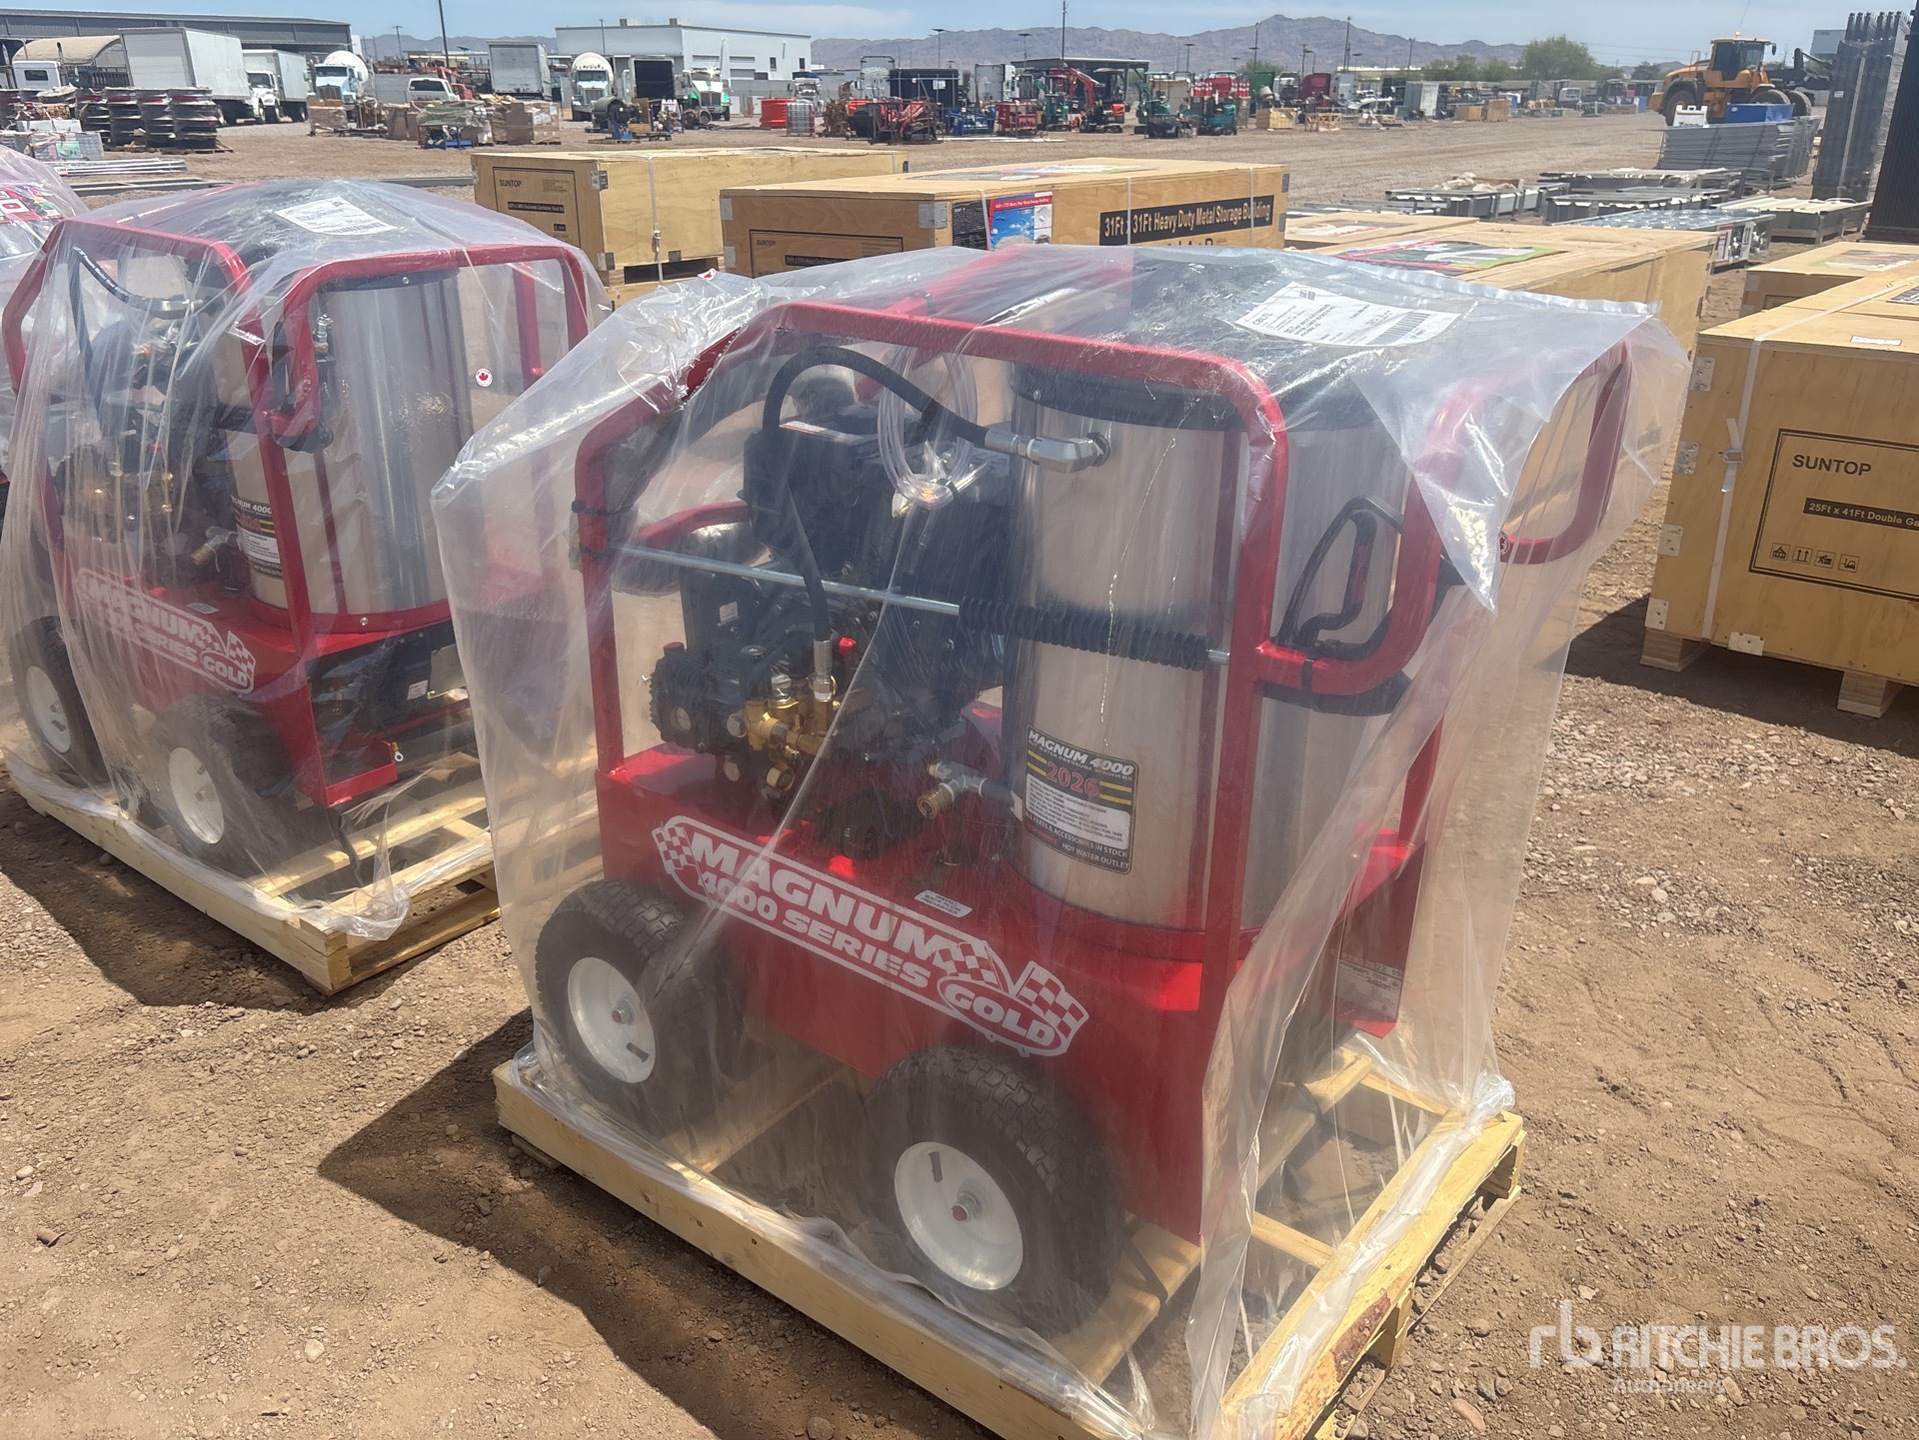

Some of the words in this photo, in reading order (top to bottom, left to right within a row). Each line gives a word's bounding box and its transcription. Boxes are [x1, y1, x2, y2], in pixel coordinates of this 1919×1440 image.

[499, 179, 522, 189] SUNTOP
[1104, 216, 1124, 237] 31Ft
[1133, 213, 1153, 234] 31Ft
[1154, 212, 1177, 233] Heavy
[1178, 210, 1195, 231] Duty
[1196, 207, 1215, 225] Metal
[1216, 205, 1242, 225] Storage
[1243, 201, 1270, 221] Bulding
[1792, 454, 1872, 476] SUNTOP
[1808, 502, 1831, 514] 25Ft
[1833, 507, 1840, 515] x
[1842, 506, 1865, 519] 41Ft
[1867, 511, 1903, 525] Double
[203, 656, 248, 688] GOLD
[1028, 729, 1088, 765] MAGNUM
[1090, 757, 1134, 776] 4000
[1046, 761, 1100, 798] 2026
[1061, 841, 1075, 852] HOT
[1076, 848, 1100, 861] WATER
[1100, 856, 1130, 869] OUTLET
[1104, 846, 1128, 858] STOCK
[690, 831, 956, 961] MAGNUM
[698, 871, 780, 922] 4000
[782, 910, 932, 989] SERIES
[944, 983, 1056, 1047] GOLD
